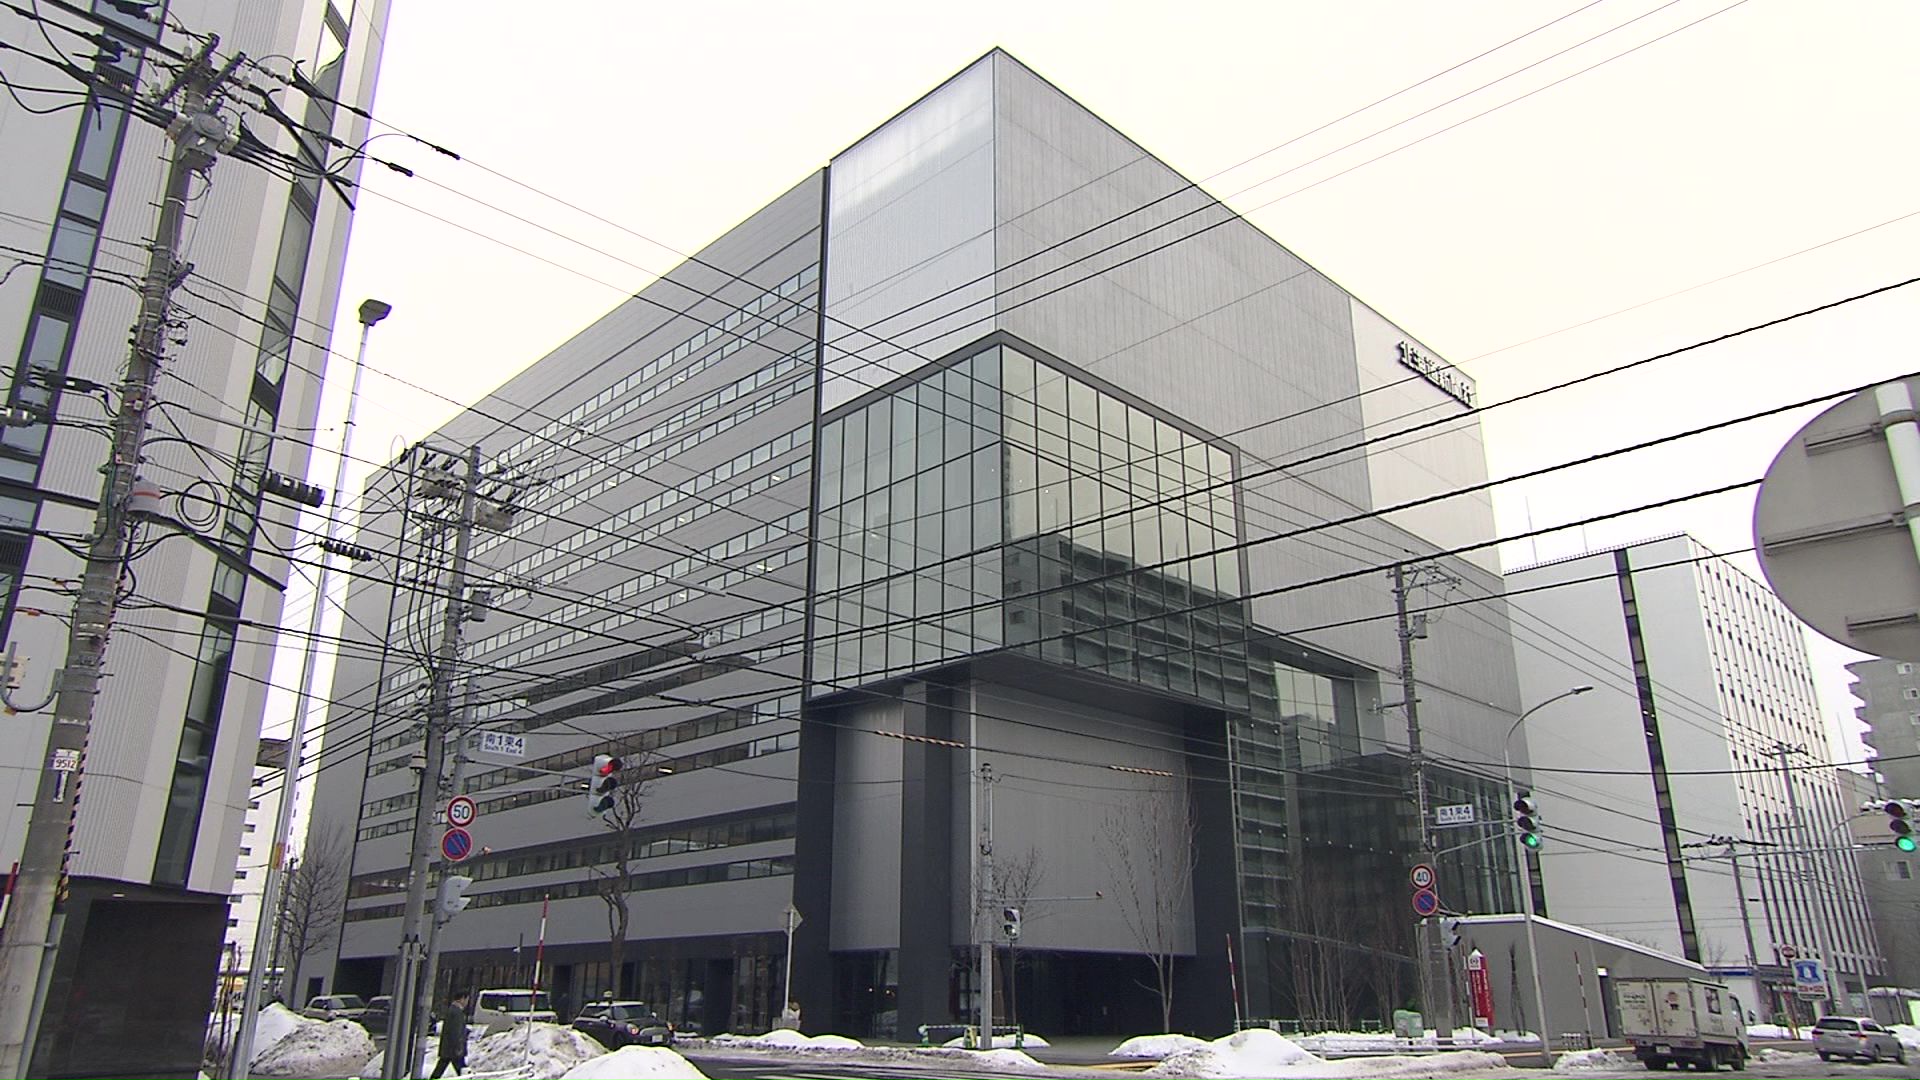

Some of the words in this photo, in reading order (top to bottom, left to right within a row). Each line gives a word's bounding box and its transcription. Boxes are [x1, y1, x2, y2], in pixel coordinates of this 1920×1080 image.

[486, 733, 523, 748] 南1東4
[55, 758, 77, 770] 9512
[453, 805, 470, 819] 50
[1415, 868, 1429, 882] 40
